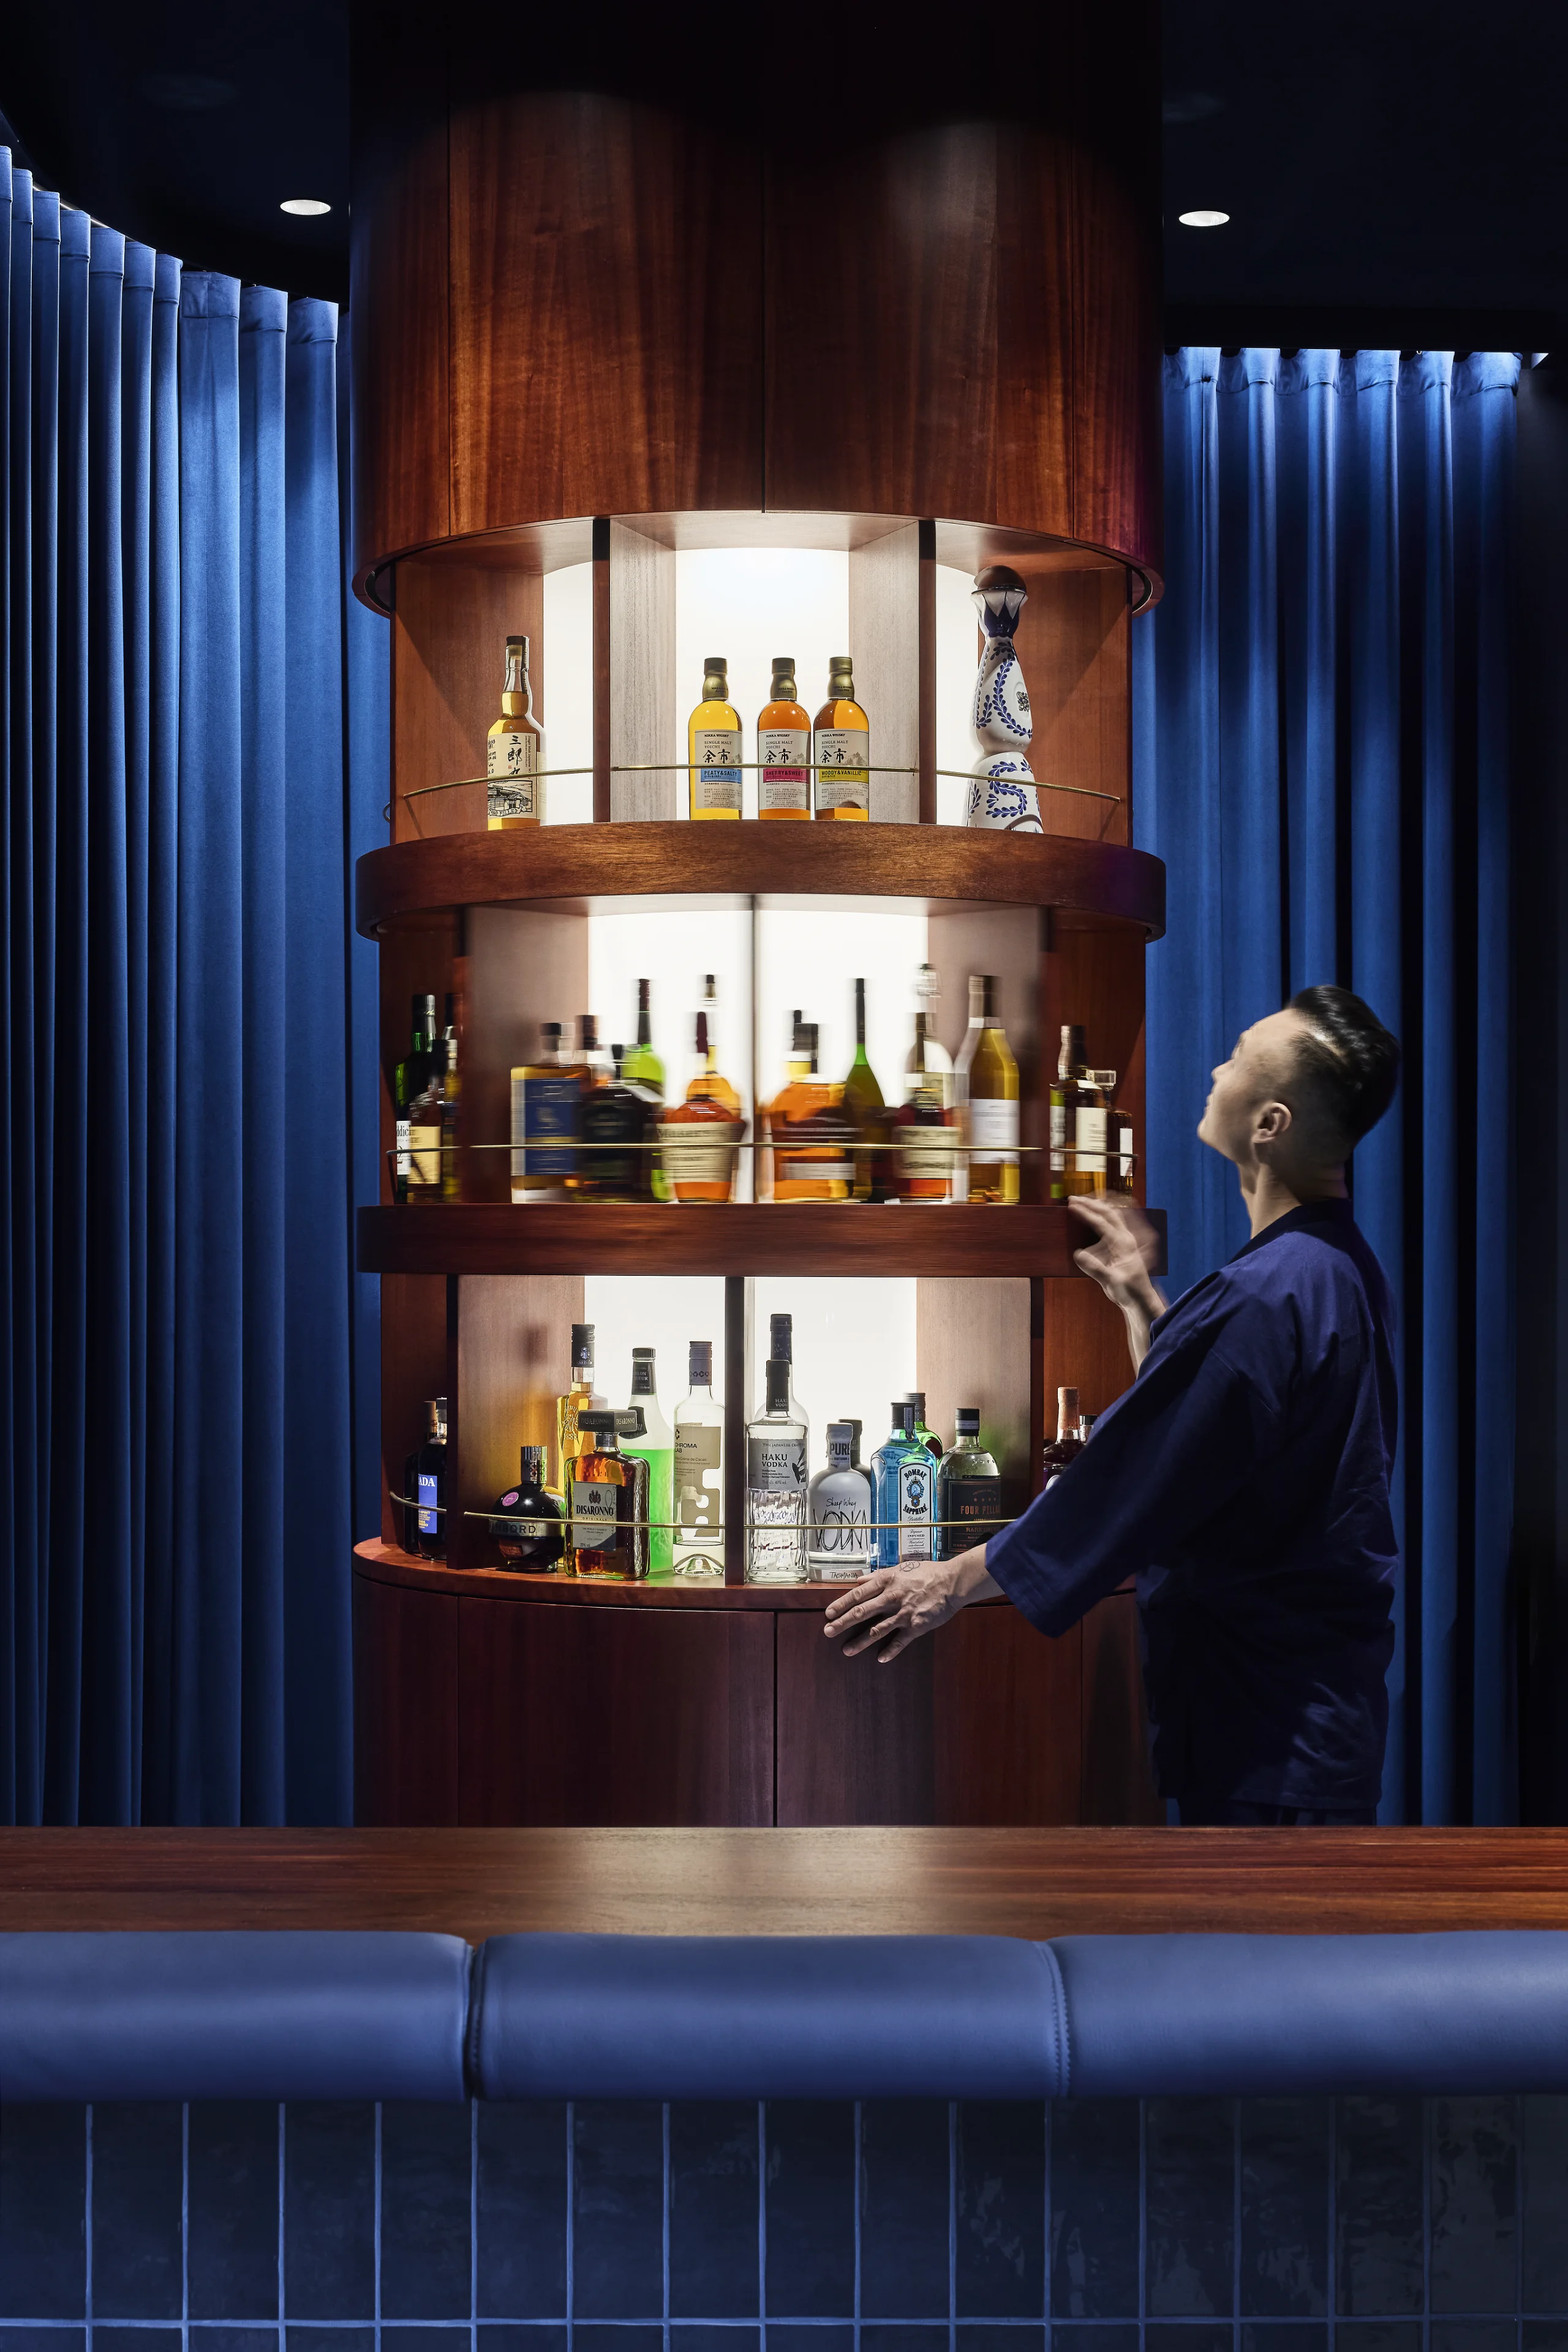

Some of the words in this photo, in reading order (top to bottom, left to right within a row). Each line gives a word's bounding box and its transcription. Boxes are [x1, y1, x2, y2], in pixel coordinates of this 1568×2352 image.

[703, 748, 730, 764] 余市
[764, 748, 791, 764] 余市
[820, 748, 846, 764] 余市
[903, 1469, 927, 1480] BOMBAY
[576, 1504, 613, 1516] DISARONNO
[826, 1497, 842, 1510] Sheep
[843, 1498, 857, 1512] Whey
[903, 1503, 928, 1515] SAPPHIRE
[960, 1506, 979, 1515] FOUR
[829, 1571, 858, 1580] TASMANIA
